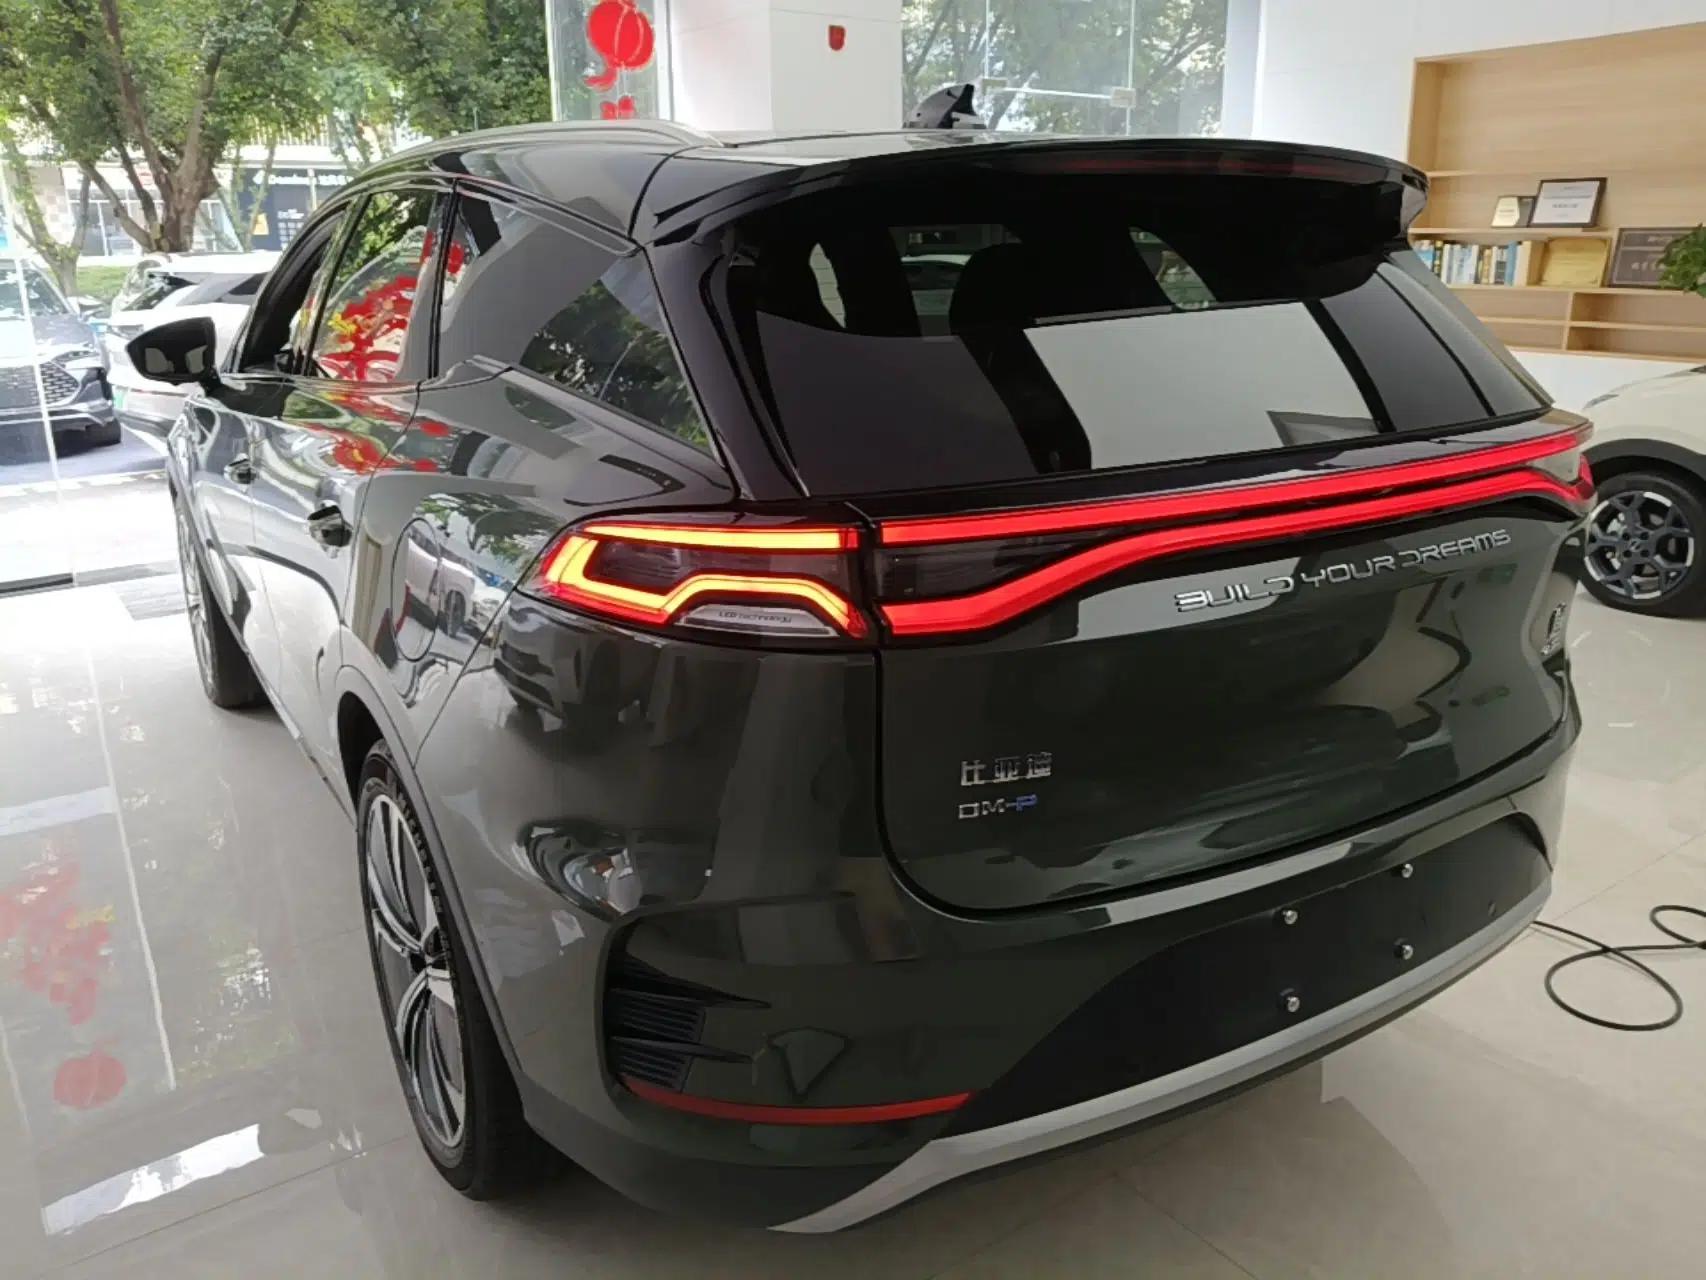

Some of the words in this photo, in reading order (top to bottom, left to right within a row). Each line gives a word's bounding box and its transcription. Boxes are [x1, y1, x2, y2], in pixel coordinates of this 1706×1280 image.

[1174, 575, 1295, 613] BUILD
[1301, 554, 1396, 588] YOUR
[1402, 528, 1512, 567] DREAMS
[960, 751, 1053, 787] 比亚迪
[958, 794, 1038, 820] DM-P
